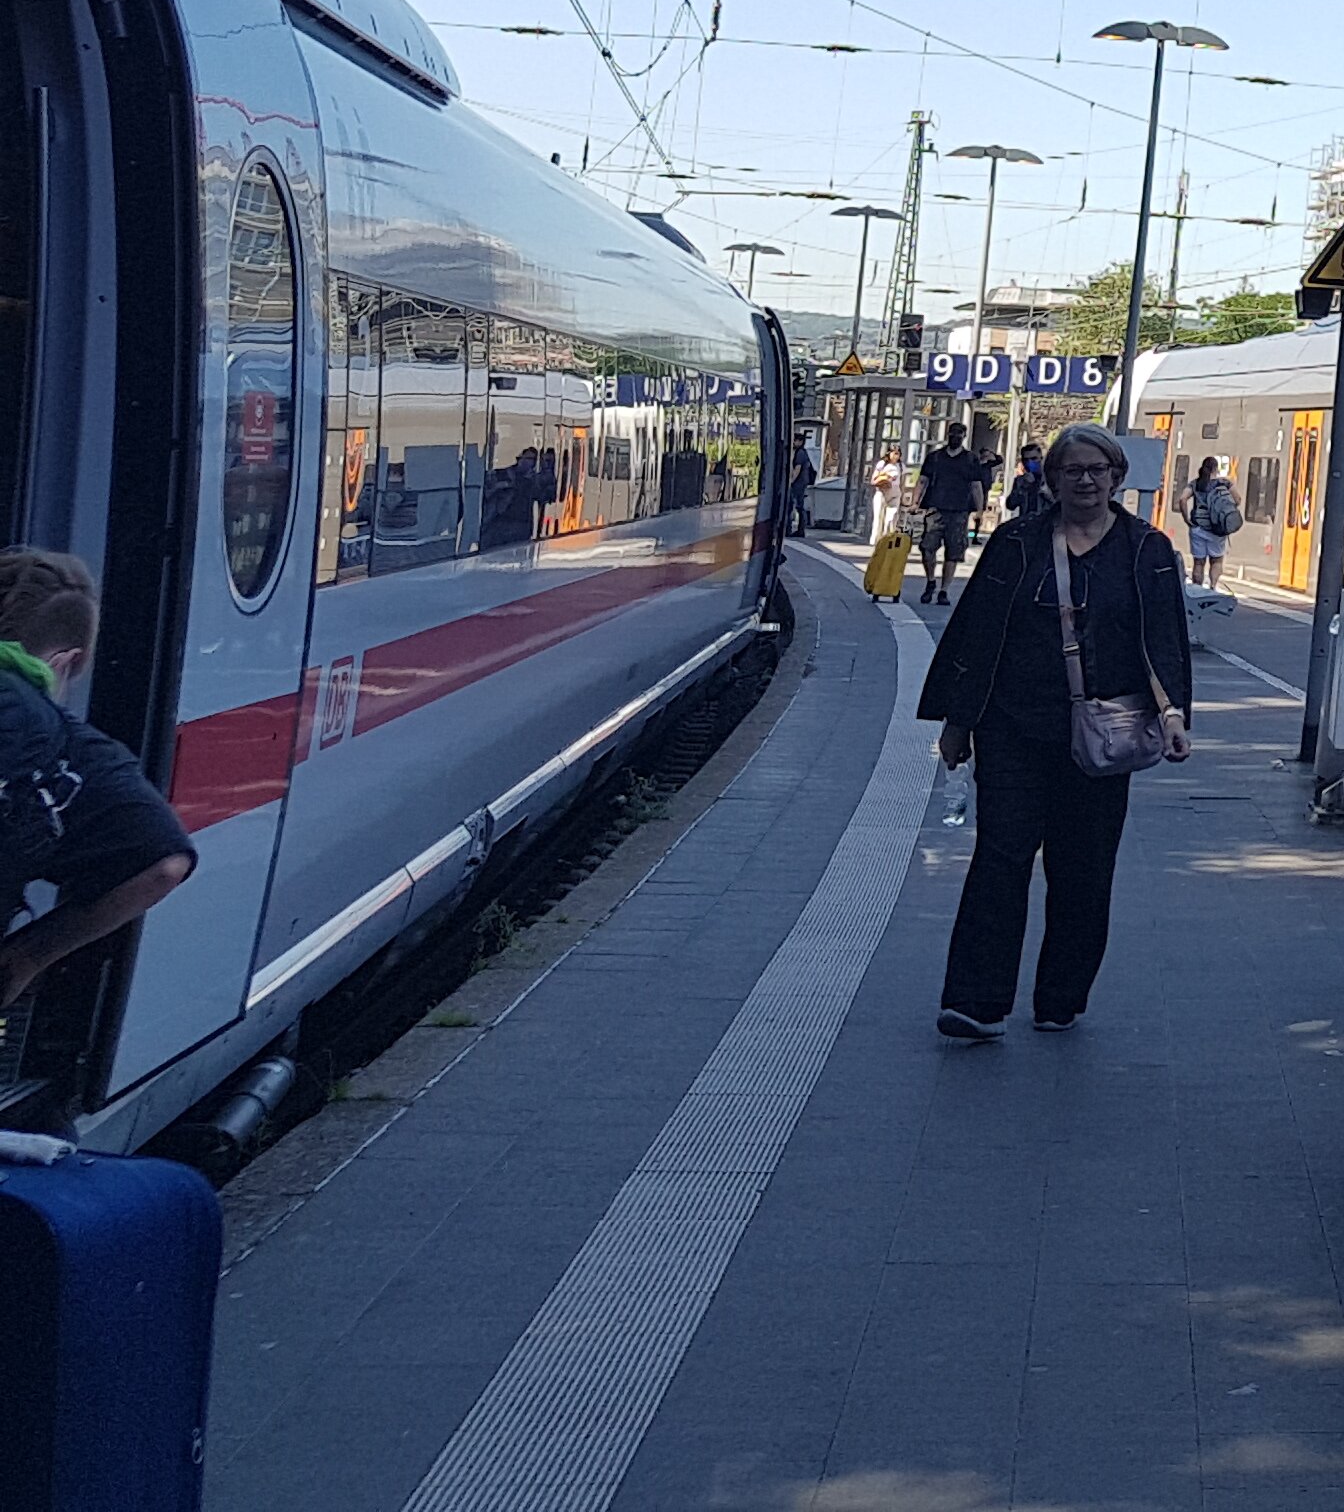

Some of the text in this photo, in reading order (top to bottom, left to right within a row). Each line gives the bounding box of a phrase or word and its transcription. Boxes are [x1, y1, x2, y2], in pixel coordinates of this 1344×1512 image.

[932, 353, 998, 384] 9 D
[1038, 357, 1062, 385] D
